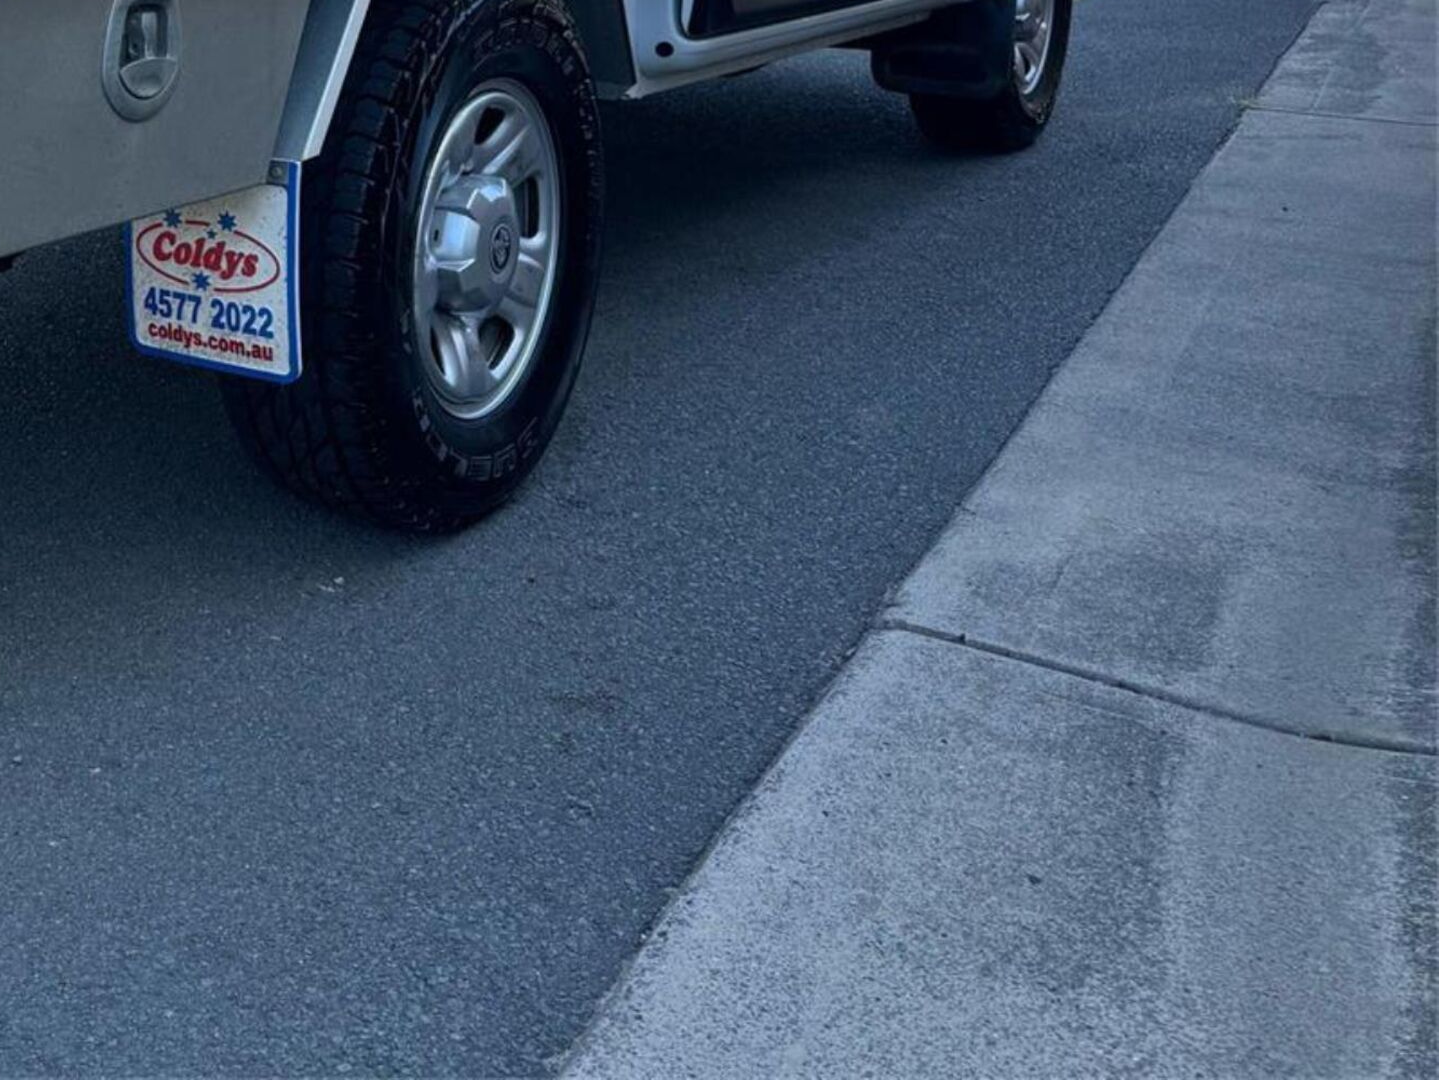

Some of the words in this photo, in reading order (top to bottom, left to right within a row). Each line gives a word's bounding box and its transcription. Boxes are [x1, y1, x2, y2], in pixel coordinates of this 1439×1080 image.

[153, 231, 258, 280] Coldys
[144, 286, 202, 324] 4577
[211, 298, 275, 340] 2022
[148, 322, 273, 361] coldys.com.au
